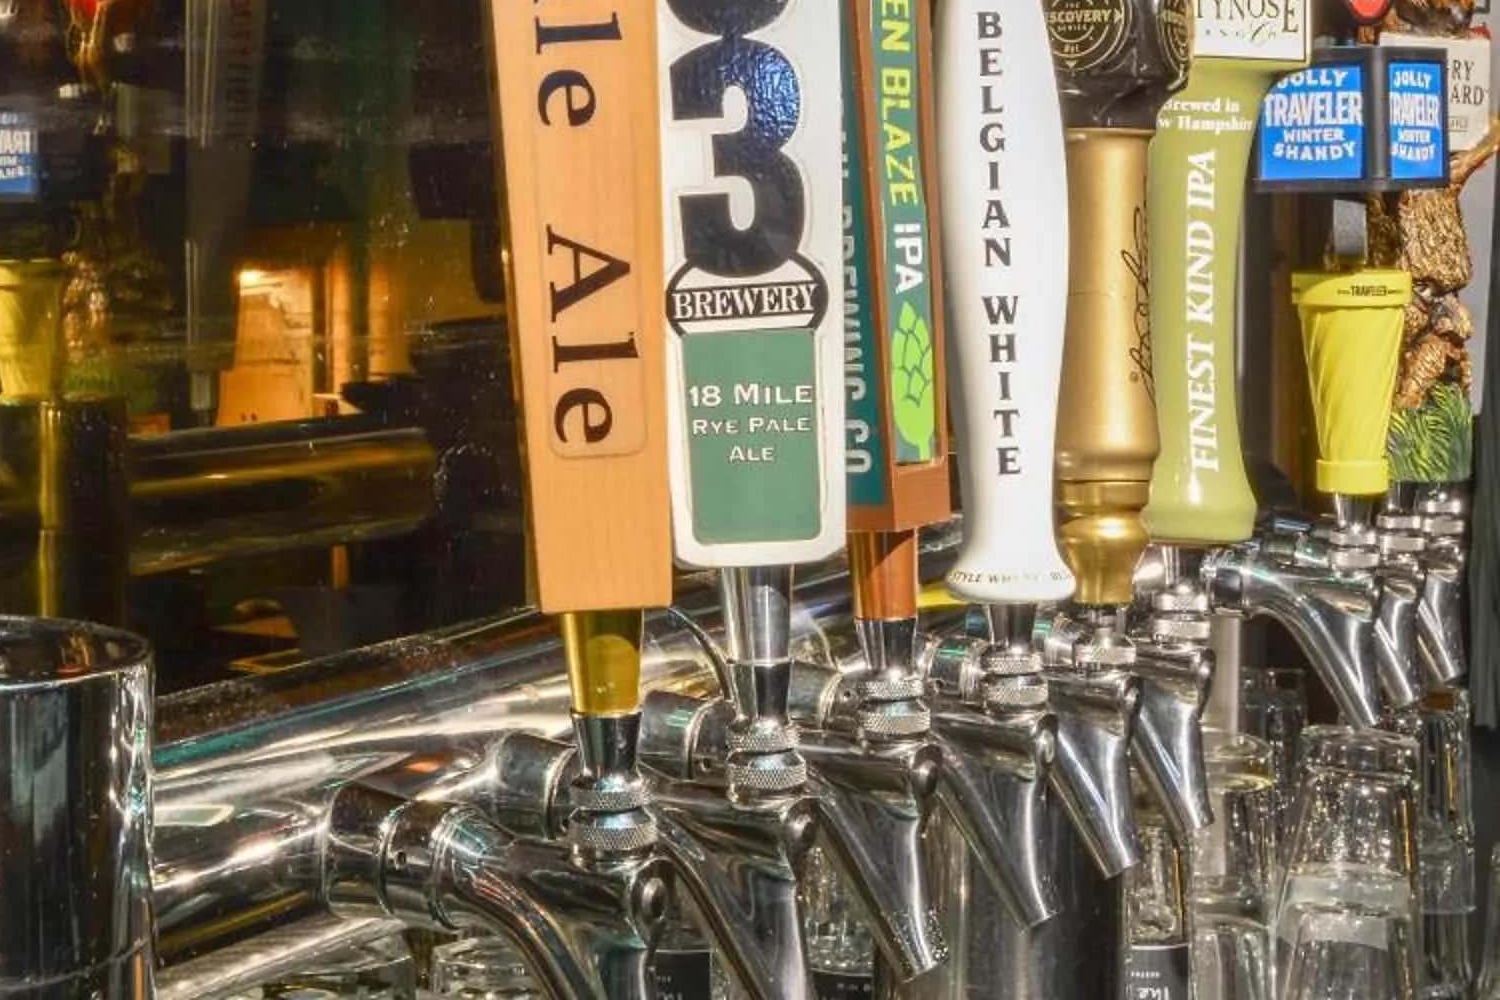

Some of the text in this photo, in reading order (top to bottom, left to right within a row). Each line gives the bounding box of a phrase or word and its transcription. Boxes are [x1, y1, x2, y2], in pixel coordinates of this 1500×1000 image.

[1277, 69, 1349, 89] JOLLY
[1393, 70, 1432, 89] JOLLY
[1225, 97, 1240, 113] in
[1264, 91, 1364, 127] TRAVELER
[1389, 92, 1440, 127] TRAVELER
[1176, 115, 1253, 135] Hampshir
[1283, 127, 1345, 143] WINTER
[881, 67, 919, 208] BLAZE
[1397, 129, 1431, 143] WINTER
[1272, 141, 1356, 161] SHANDY
[1391, 143, 1435, 161] SHANDY
[976, 10, 1022, 476] BELGIAN WHITE
[671, 283, 820, 321] BREWERY
[1186, 149, 1220, 473] FINEST KIND IPA
[546, 223, 639, 446] Ale
[689, 384, 722, 407] 18
